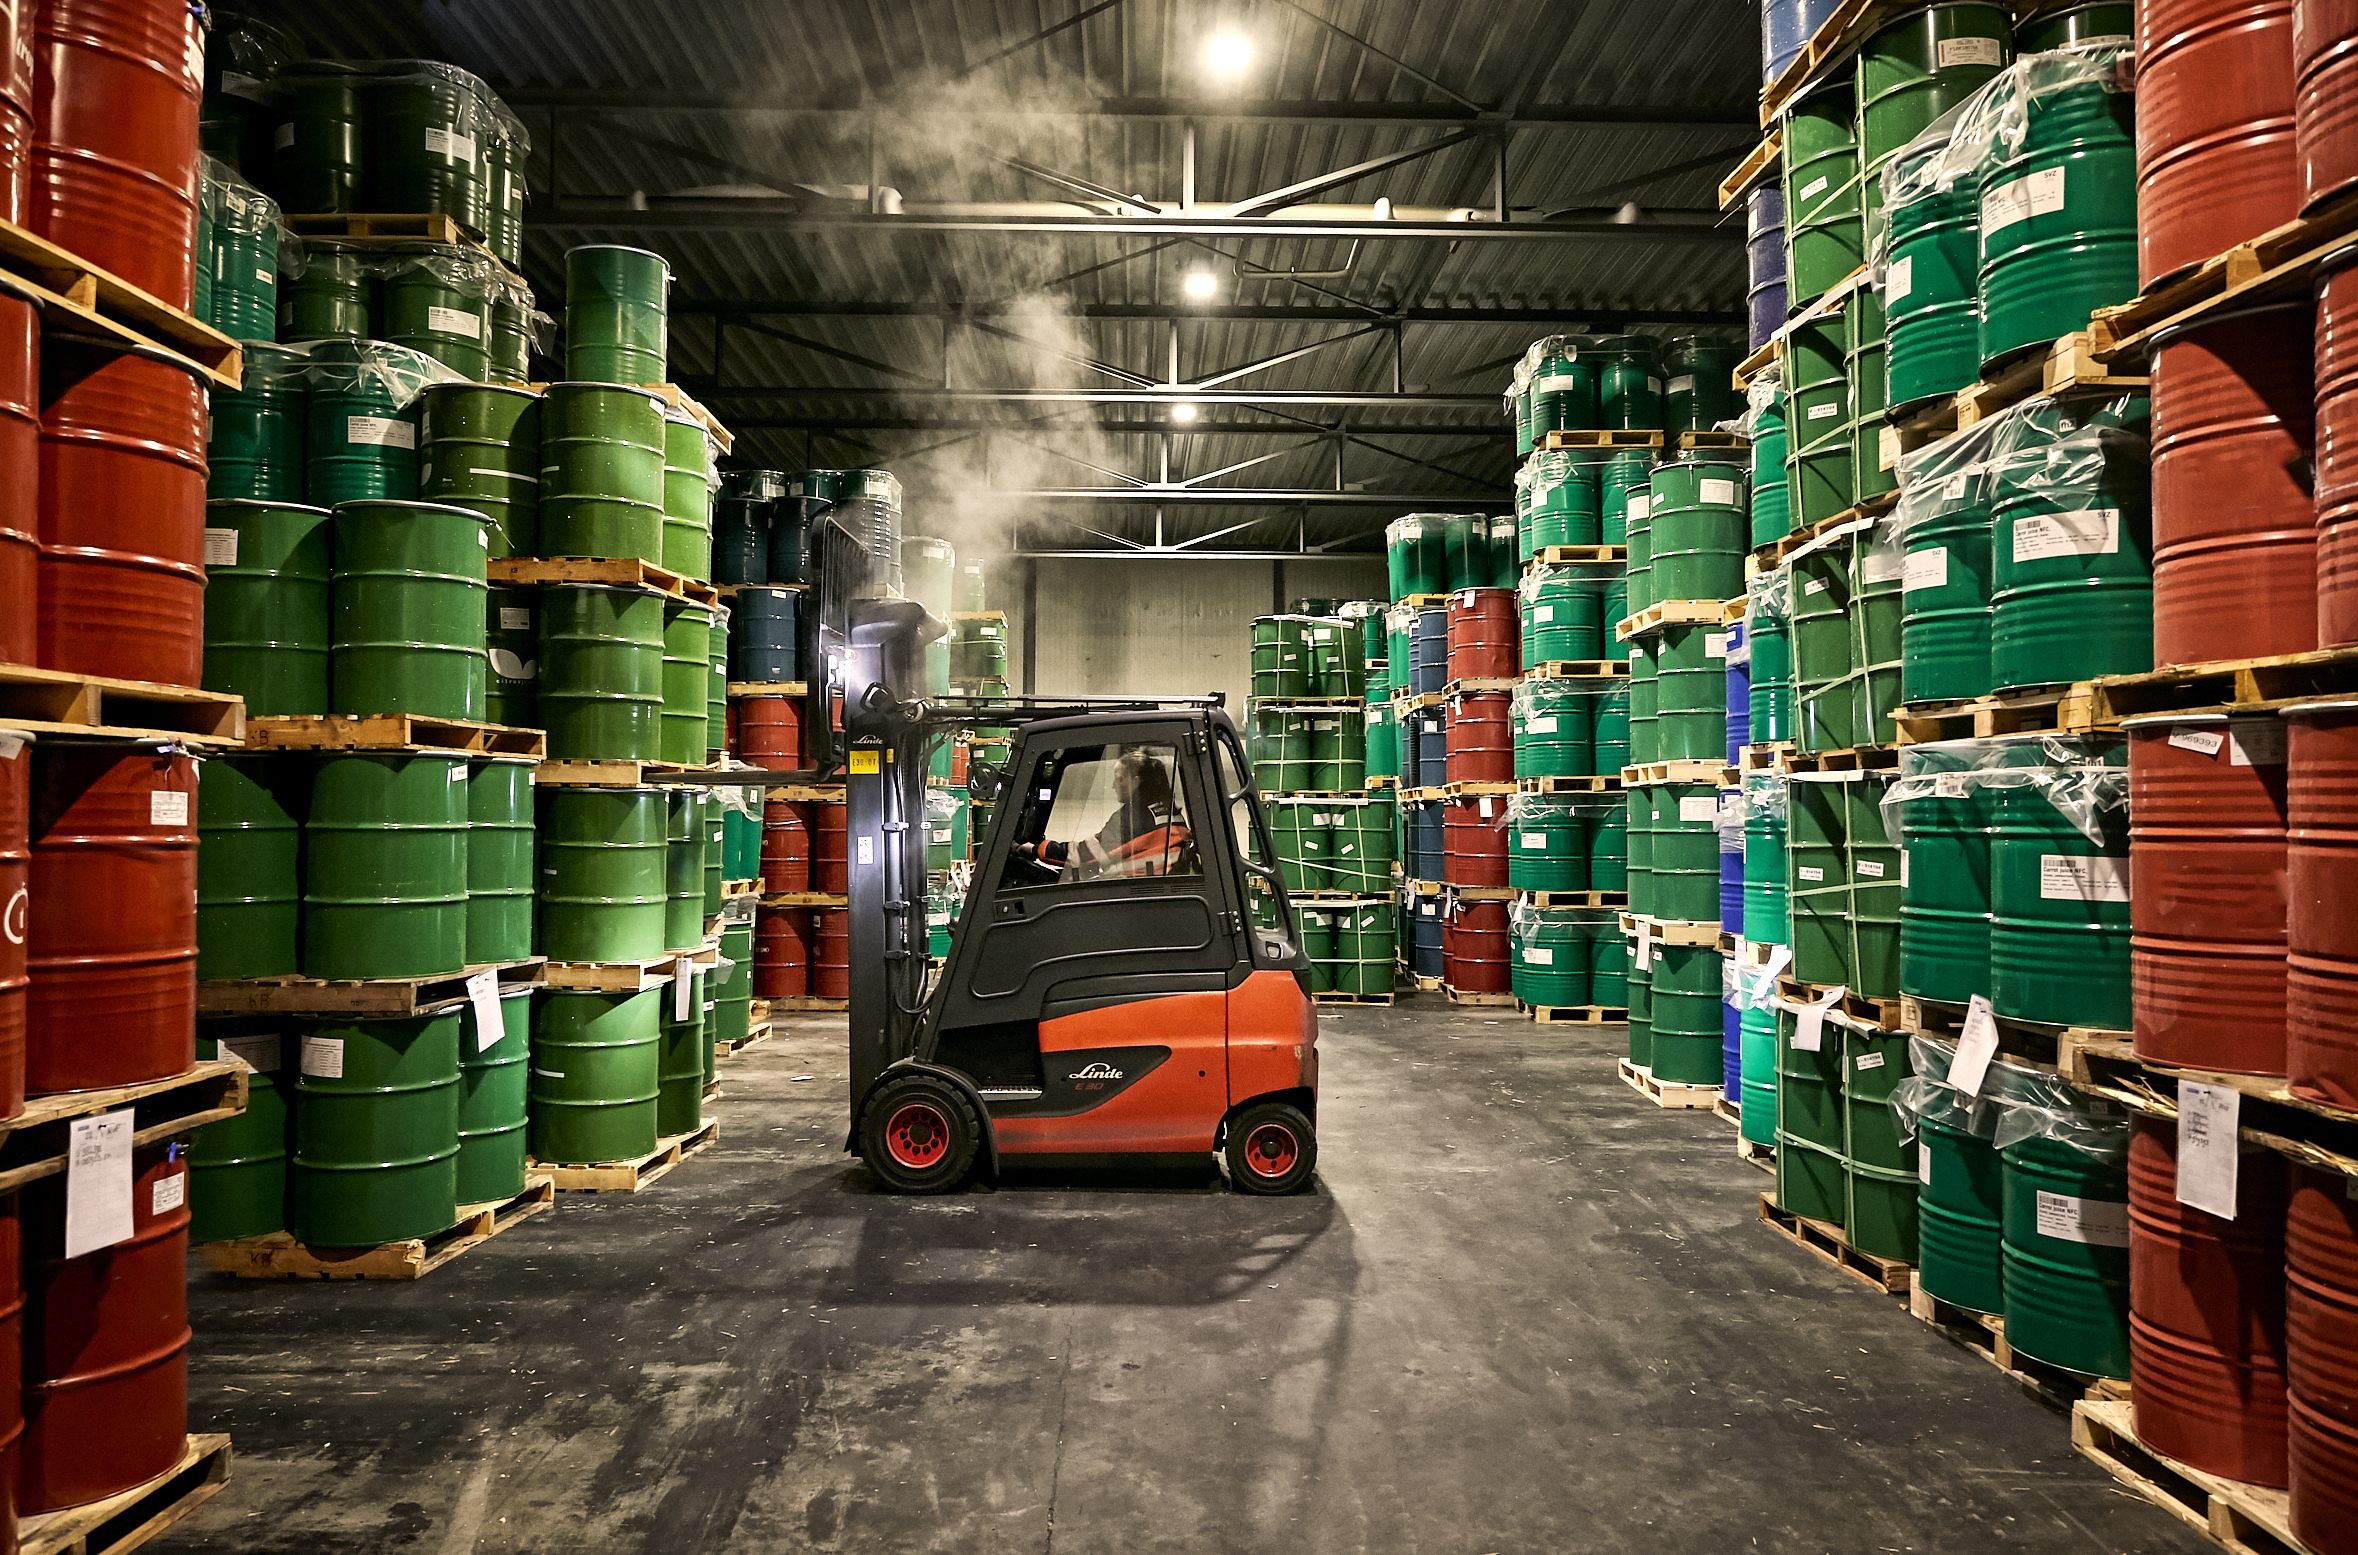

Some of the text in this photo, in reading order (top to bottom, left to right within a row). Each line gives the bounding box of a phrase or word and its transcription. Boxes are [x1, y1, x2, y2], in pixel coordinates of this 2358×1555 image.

[2044, 170, 2057, 179] SVZ
[853, 734, 884, 745] Linde
[2172, 731, 2218, 748] V-969393
[1068, 1062, 1124, 1079] Linde
[1075, 1082, 1104, 1091] E 30
[2038, 1202, 2053, 1211] Carrot
[2053, 1205, 2066, 1214] juice
